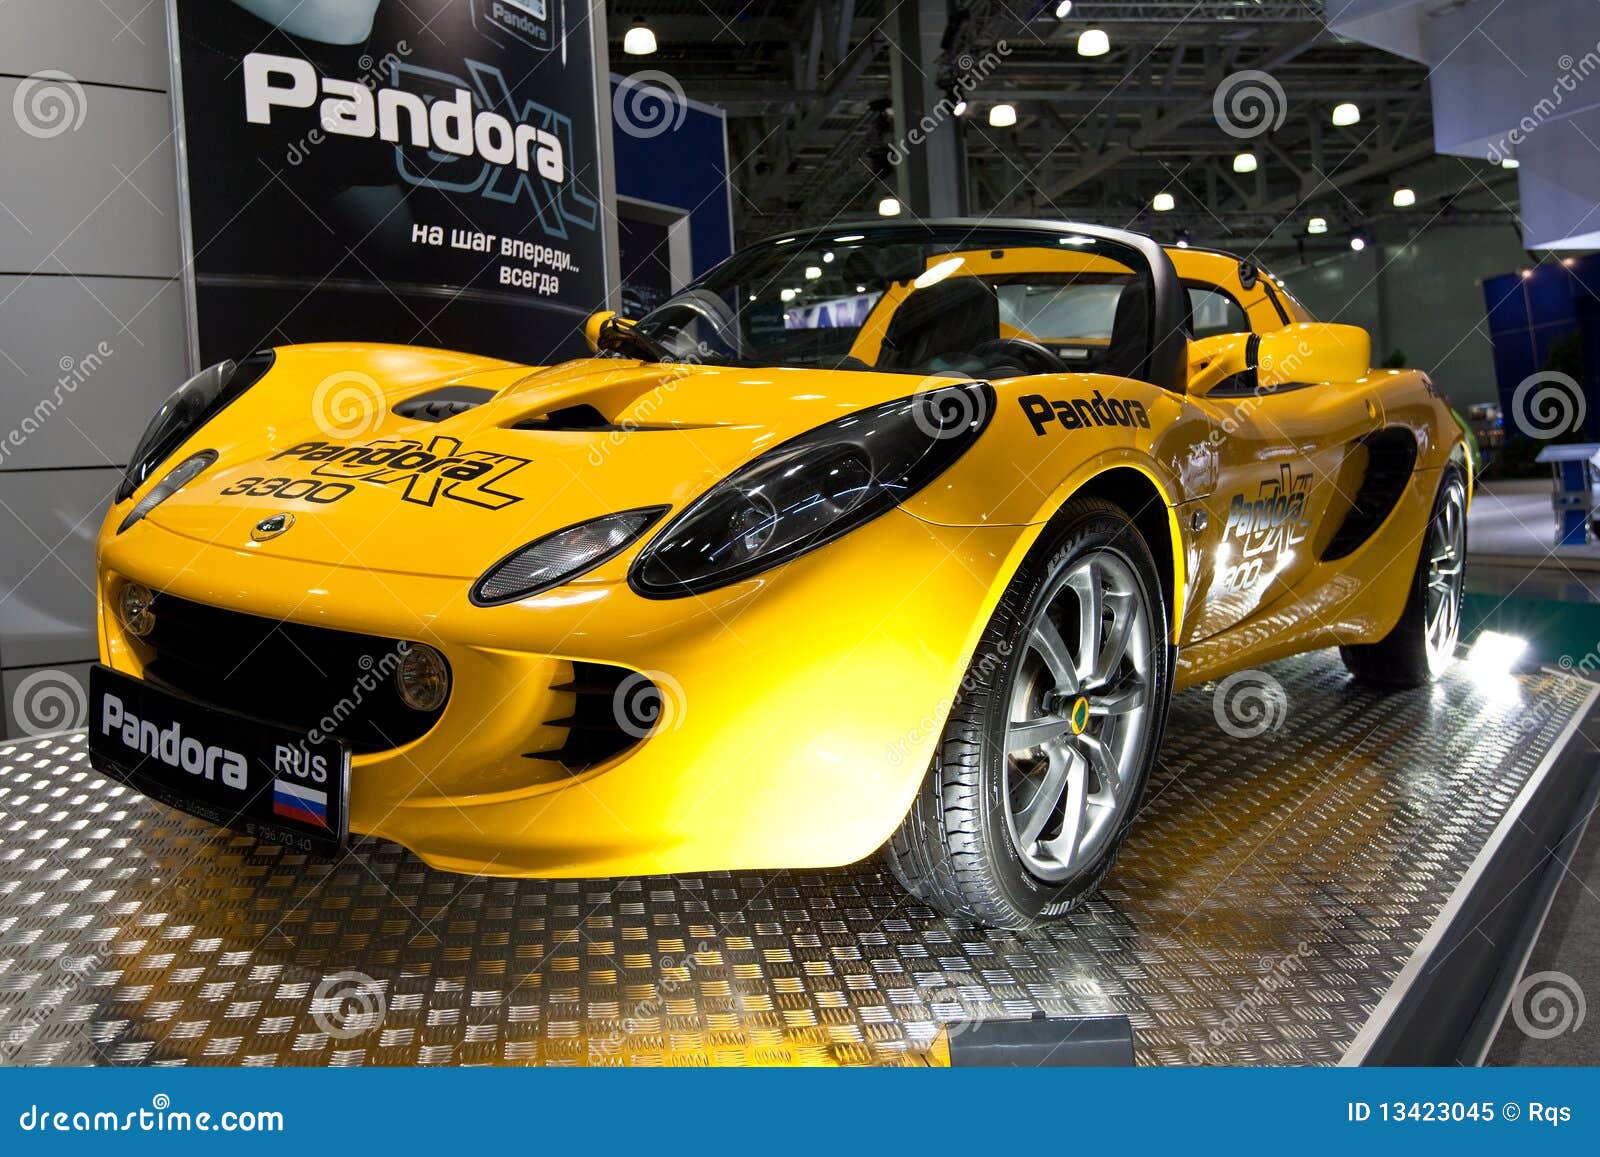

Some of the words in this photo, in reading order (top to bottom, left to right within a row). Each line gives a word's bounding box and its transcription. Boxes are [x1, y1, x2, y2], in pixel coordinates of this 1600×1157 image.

[492, 3, 547, 41] Pandora
[243, 52, 564, 183] Pandora
[411, 223, 444, 246] на
[450, 228, 496, 253] шаг
[500, 236, 580, 273] впереди...
[499, 265, 560, 296] всегда
[1018, 389, 1151, 437] Pandora
[267, 442, 494, 480] Pandora
[220, 477, 355, 504] 3300
[1221, 486, 1304, 543] Pandora
[102, 692, 248, 791] Pandora
[275, 744, 328, 783] RUS
